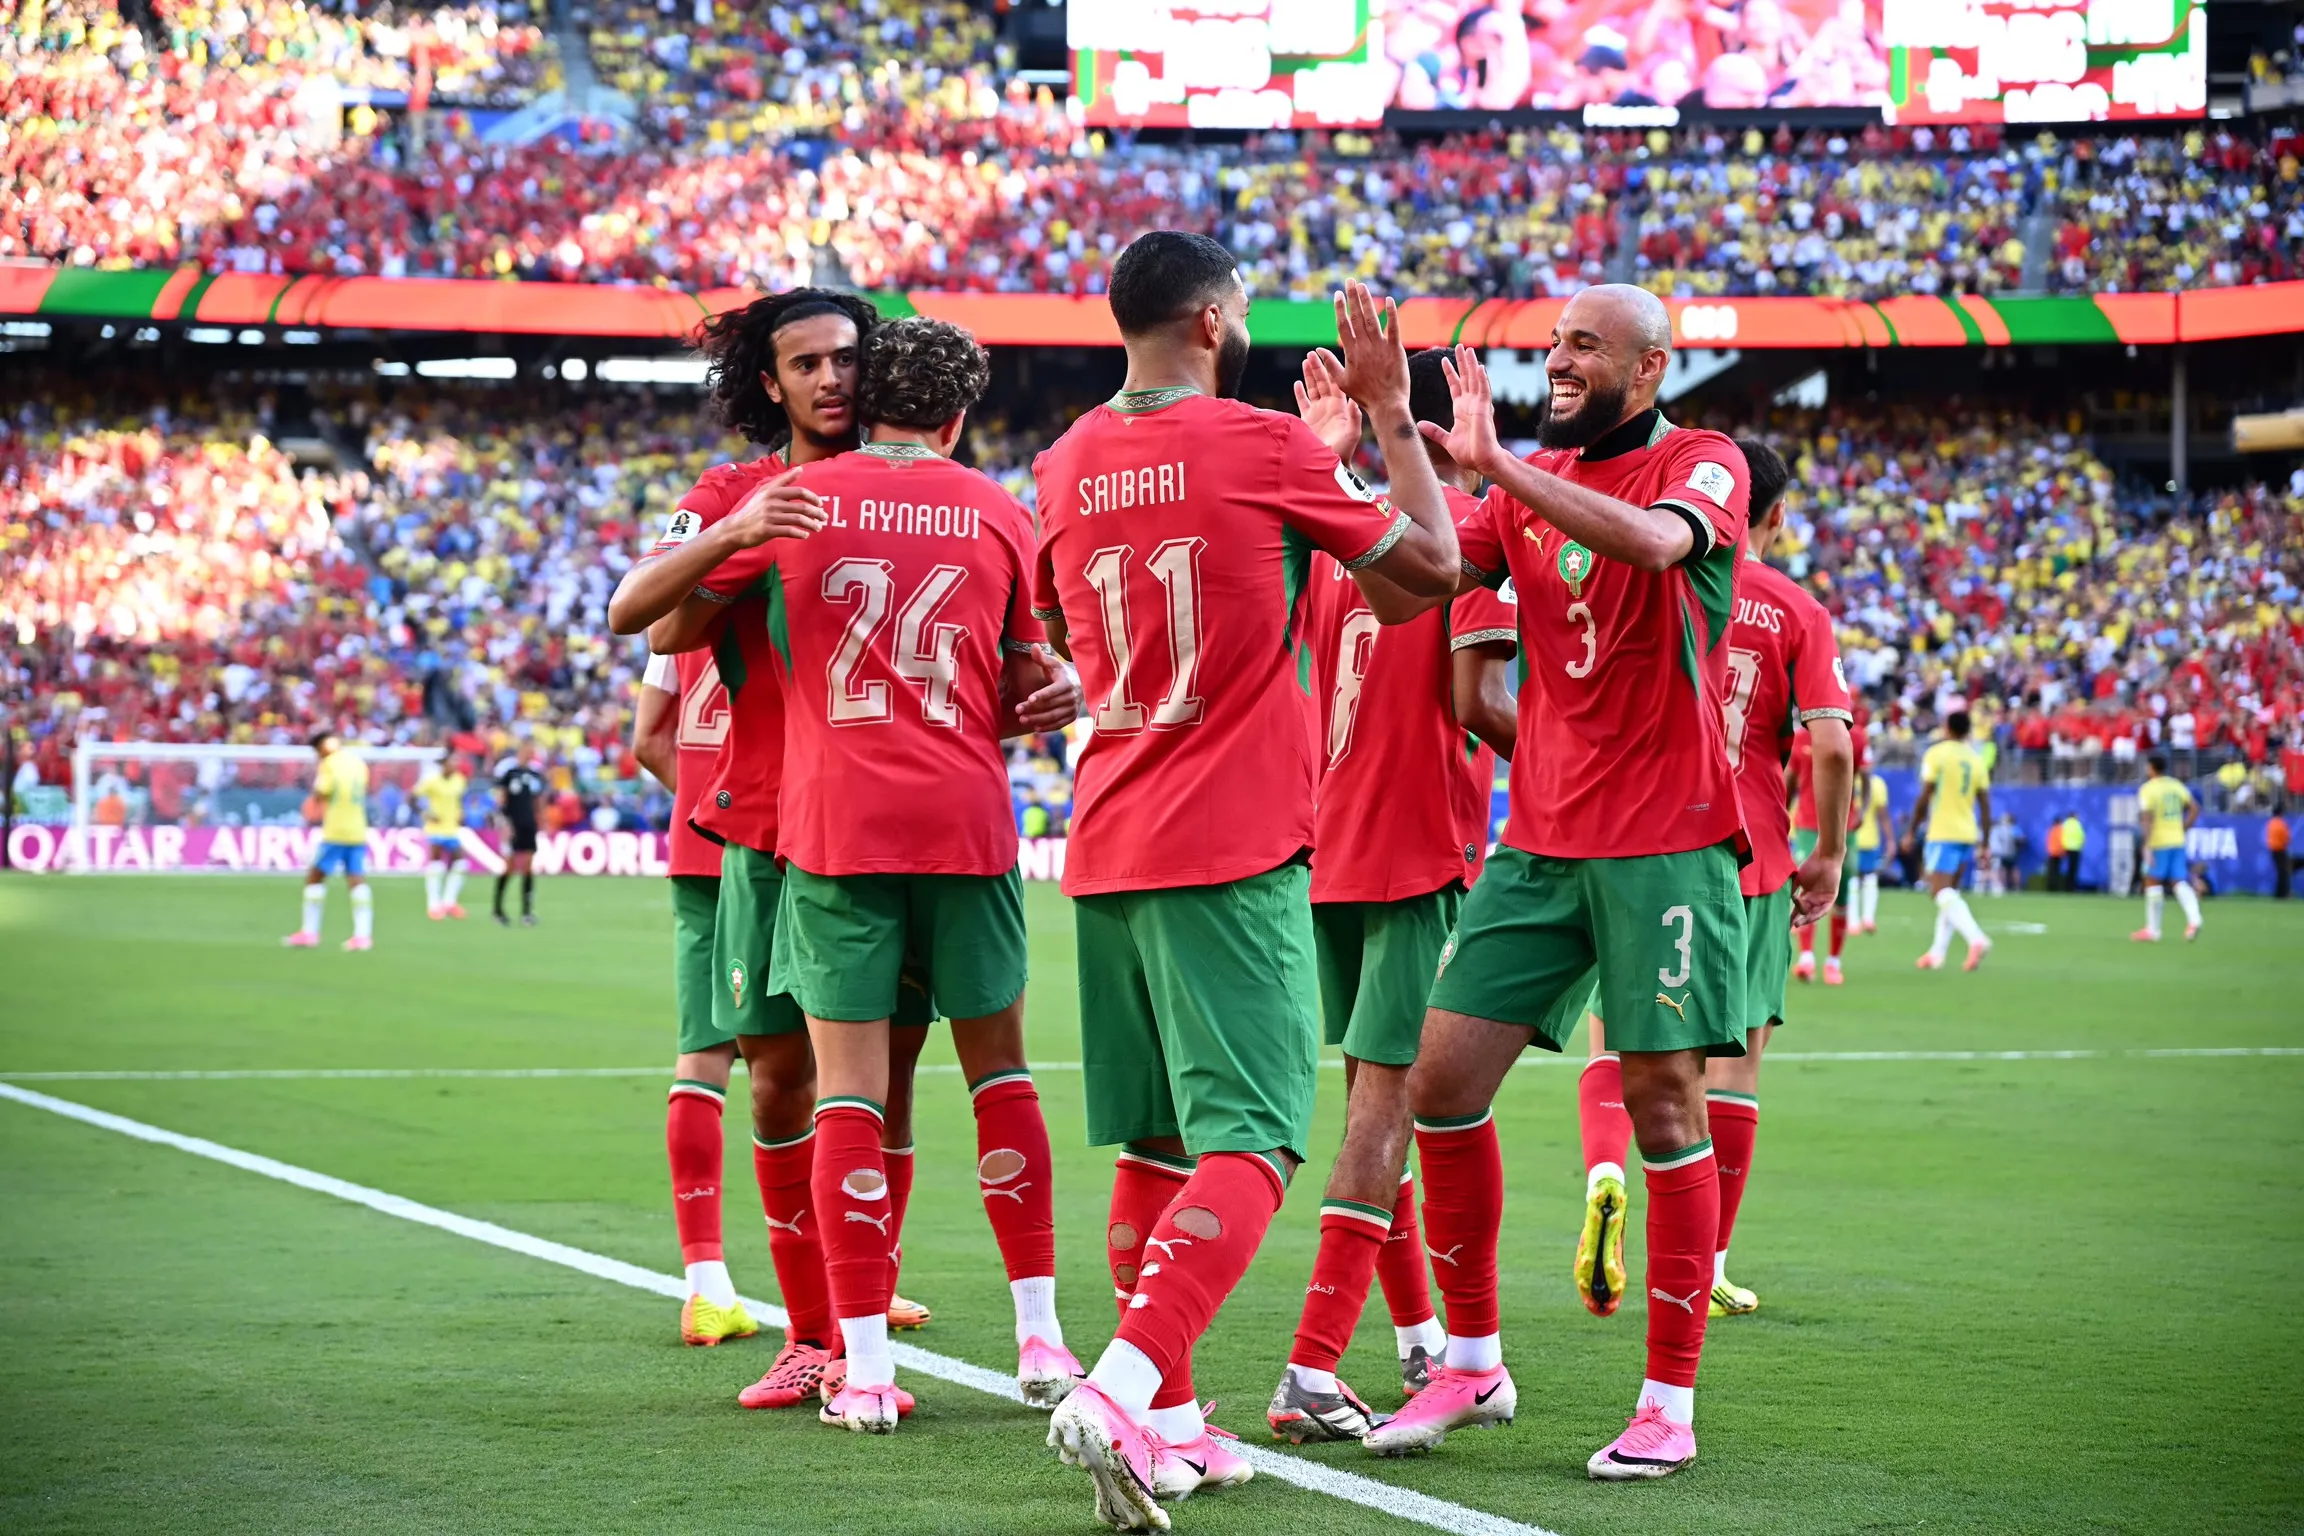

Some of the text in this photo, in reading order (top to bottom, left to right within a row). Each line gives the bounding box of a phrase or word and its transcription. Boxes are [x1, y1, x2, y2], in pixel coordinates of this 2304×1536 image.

[859, 499, 979, 540] AYNAOUI
[1078, 461, 1186, 516] SAIBARI
[821, 556, 971, 734] 24
[1083, 536, 1209, 736] 11
[1564, 601, 1597, 679] 3
[7, 823, 426, 874] QATAR AIRWYS
[531, 830, 669, 875] WORL
[1658, 905, 1694, 988] 3
